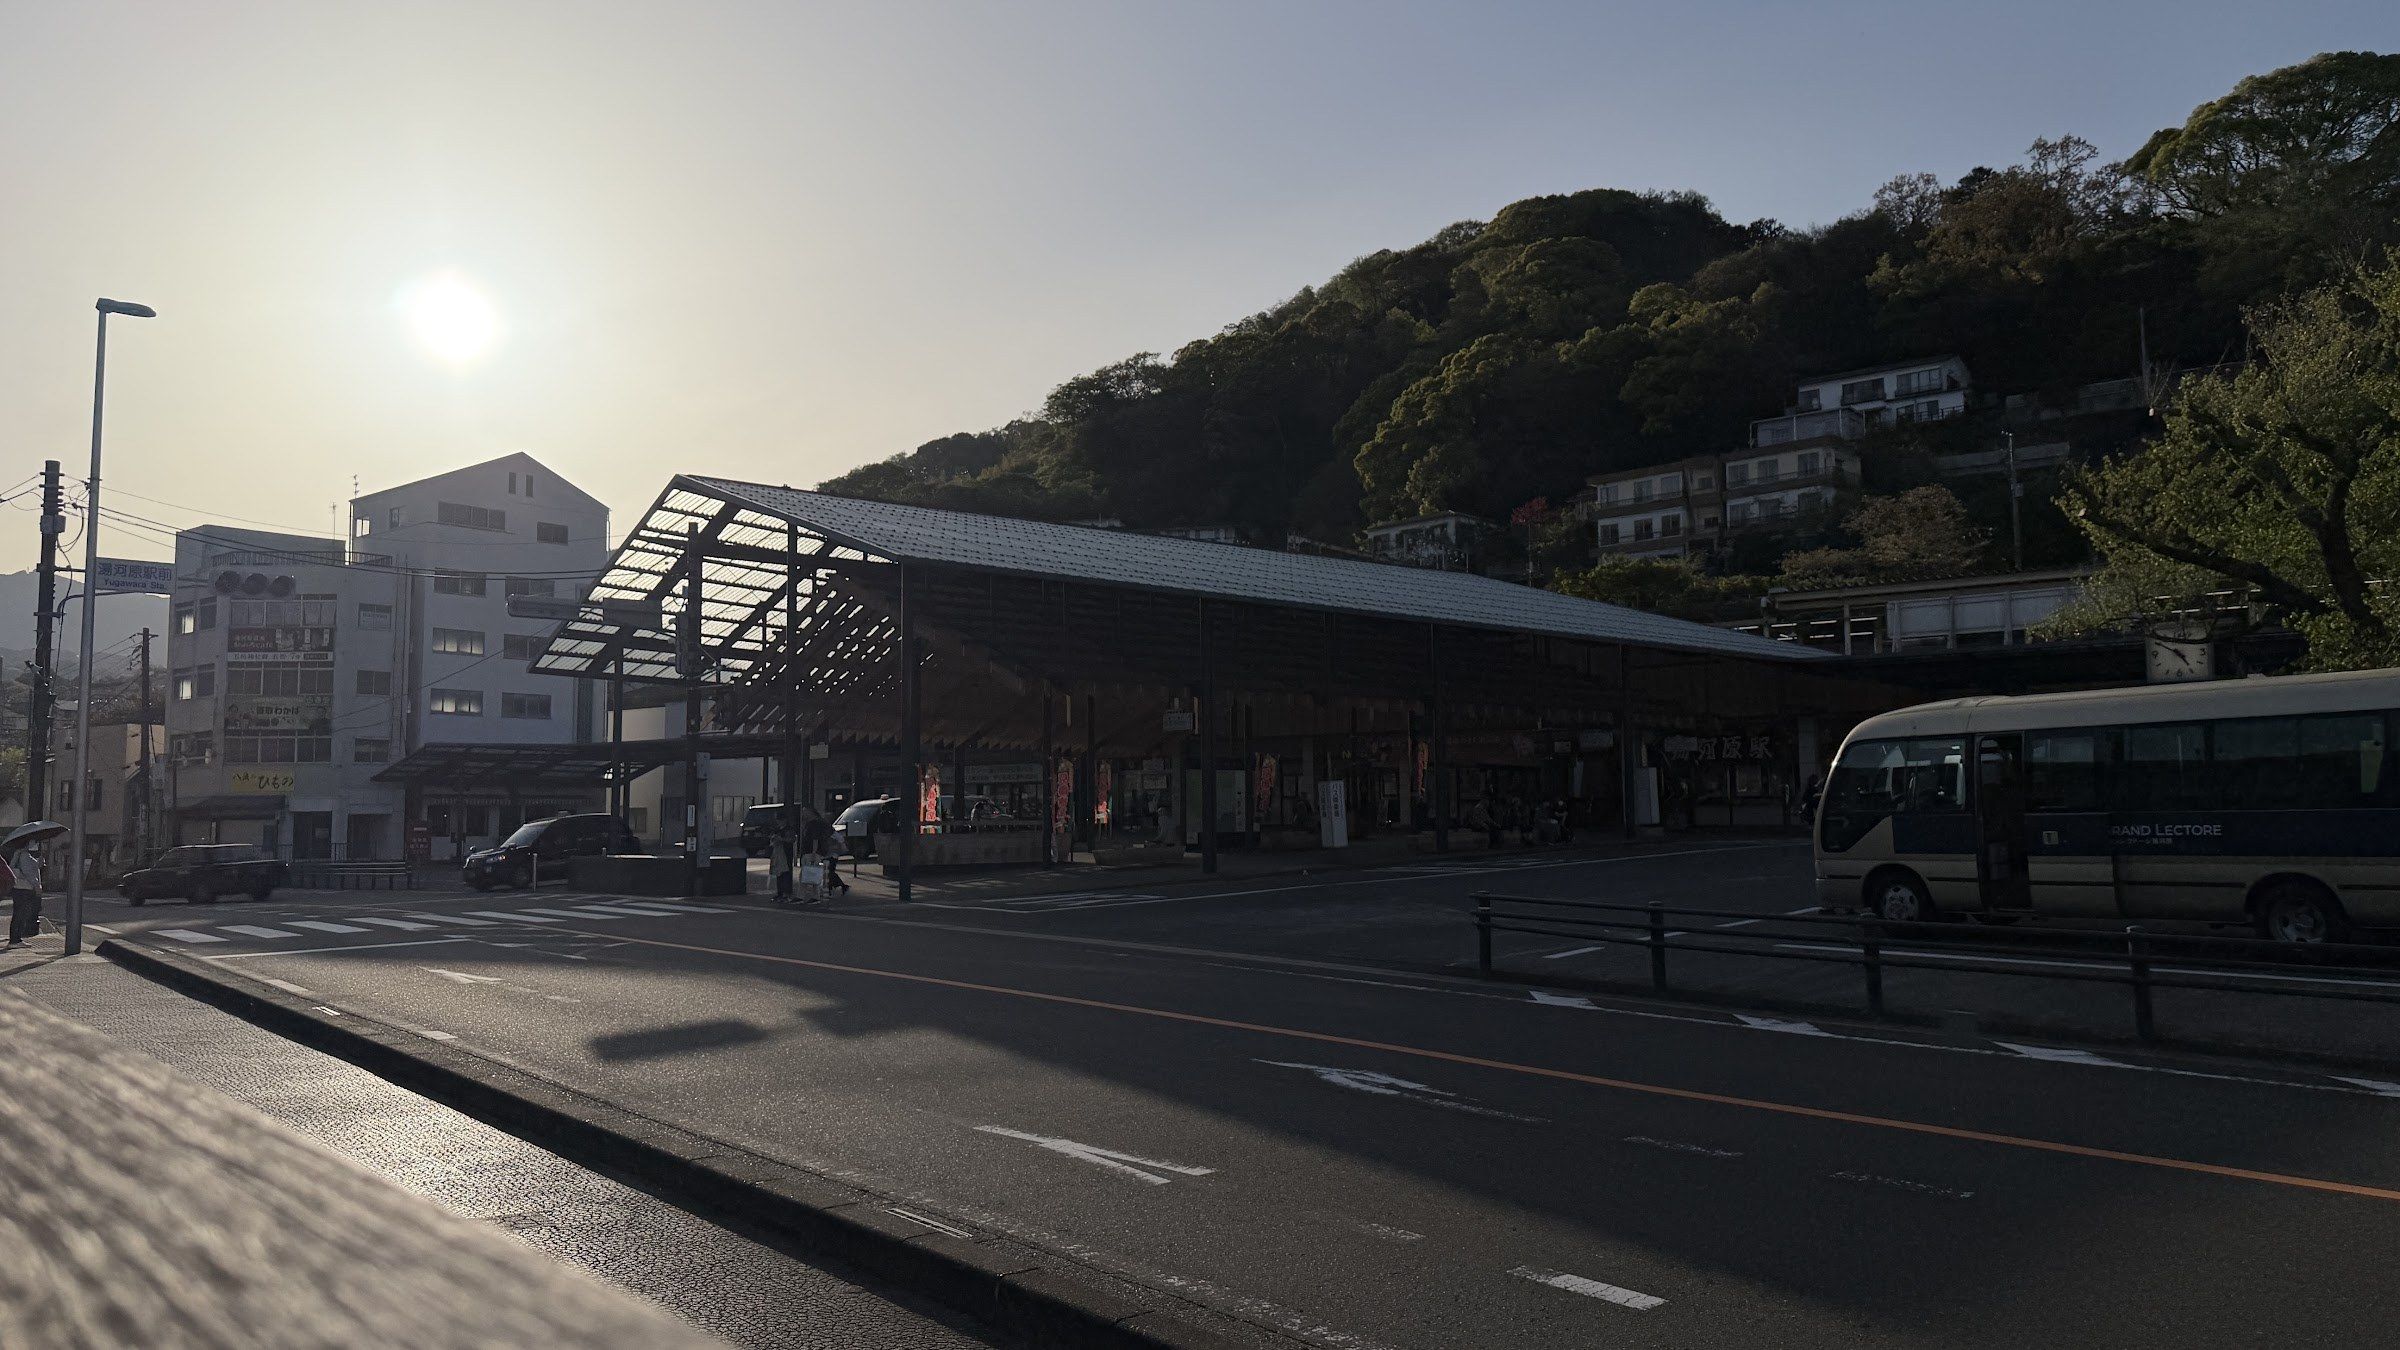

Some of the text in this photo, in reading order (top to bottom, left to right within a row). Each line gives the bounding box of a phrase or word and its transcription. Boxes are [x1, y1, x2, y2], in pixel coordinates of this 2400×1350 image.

[98, 562, 172, 581] 湯河原駅前
[104, 578, 167, 589] Yugawara Sta.
[258, 773, 294, 789] ひもの
[2112, 823, 2222, 837] RAND LECTORE
